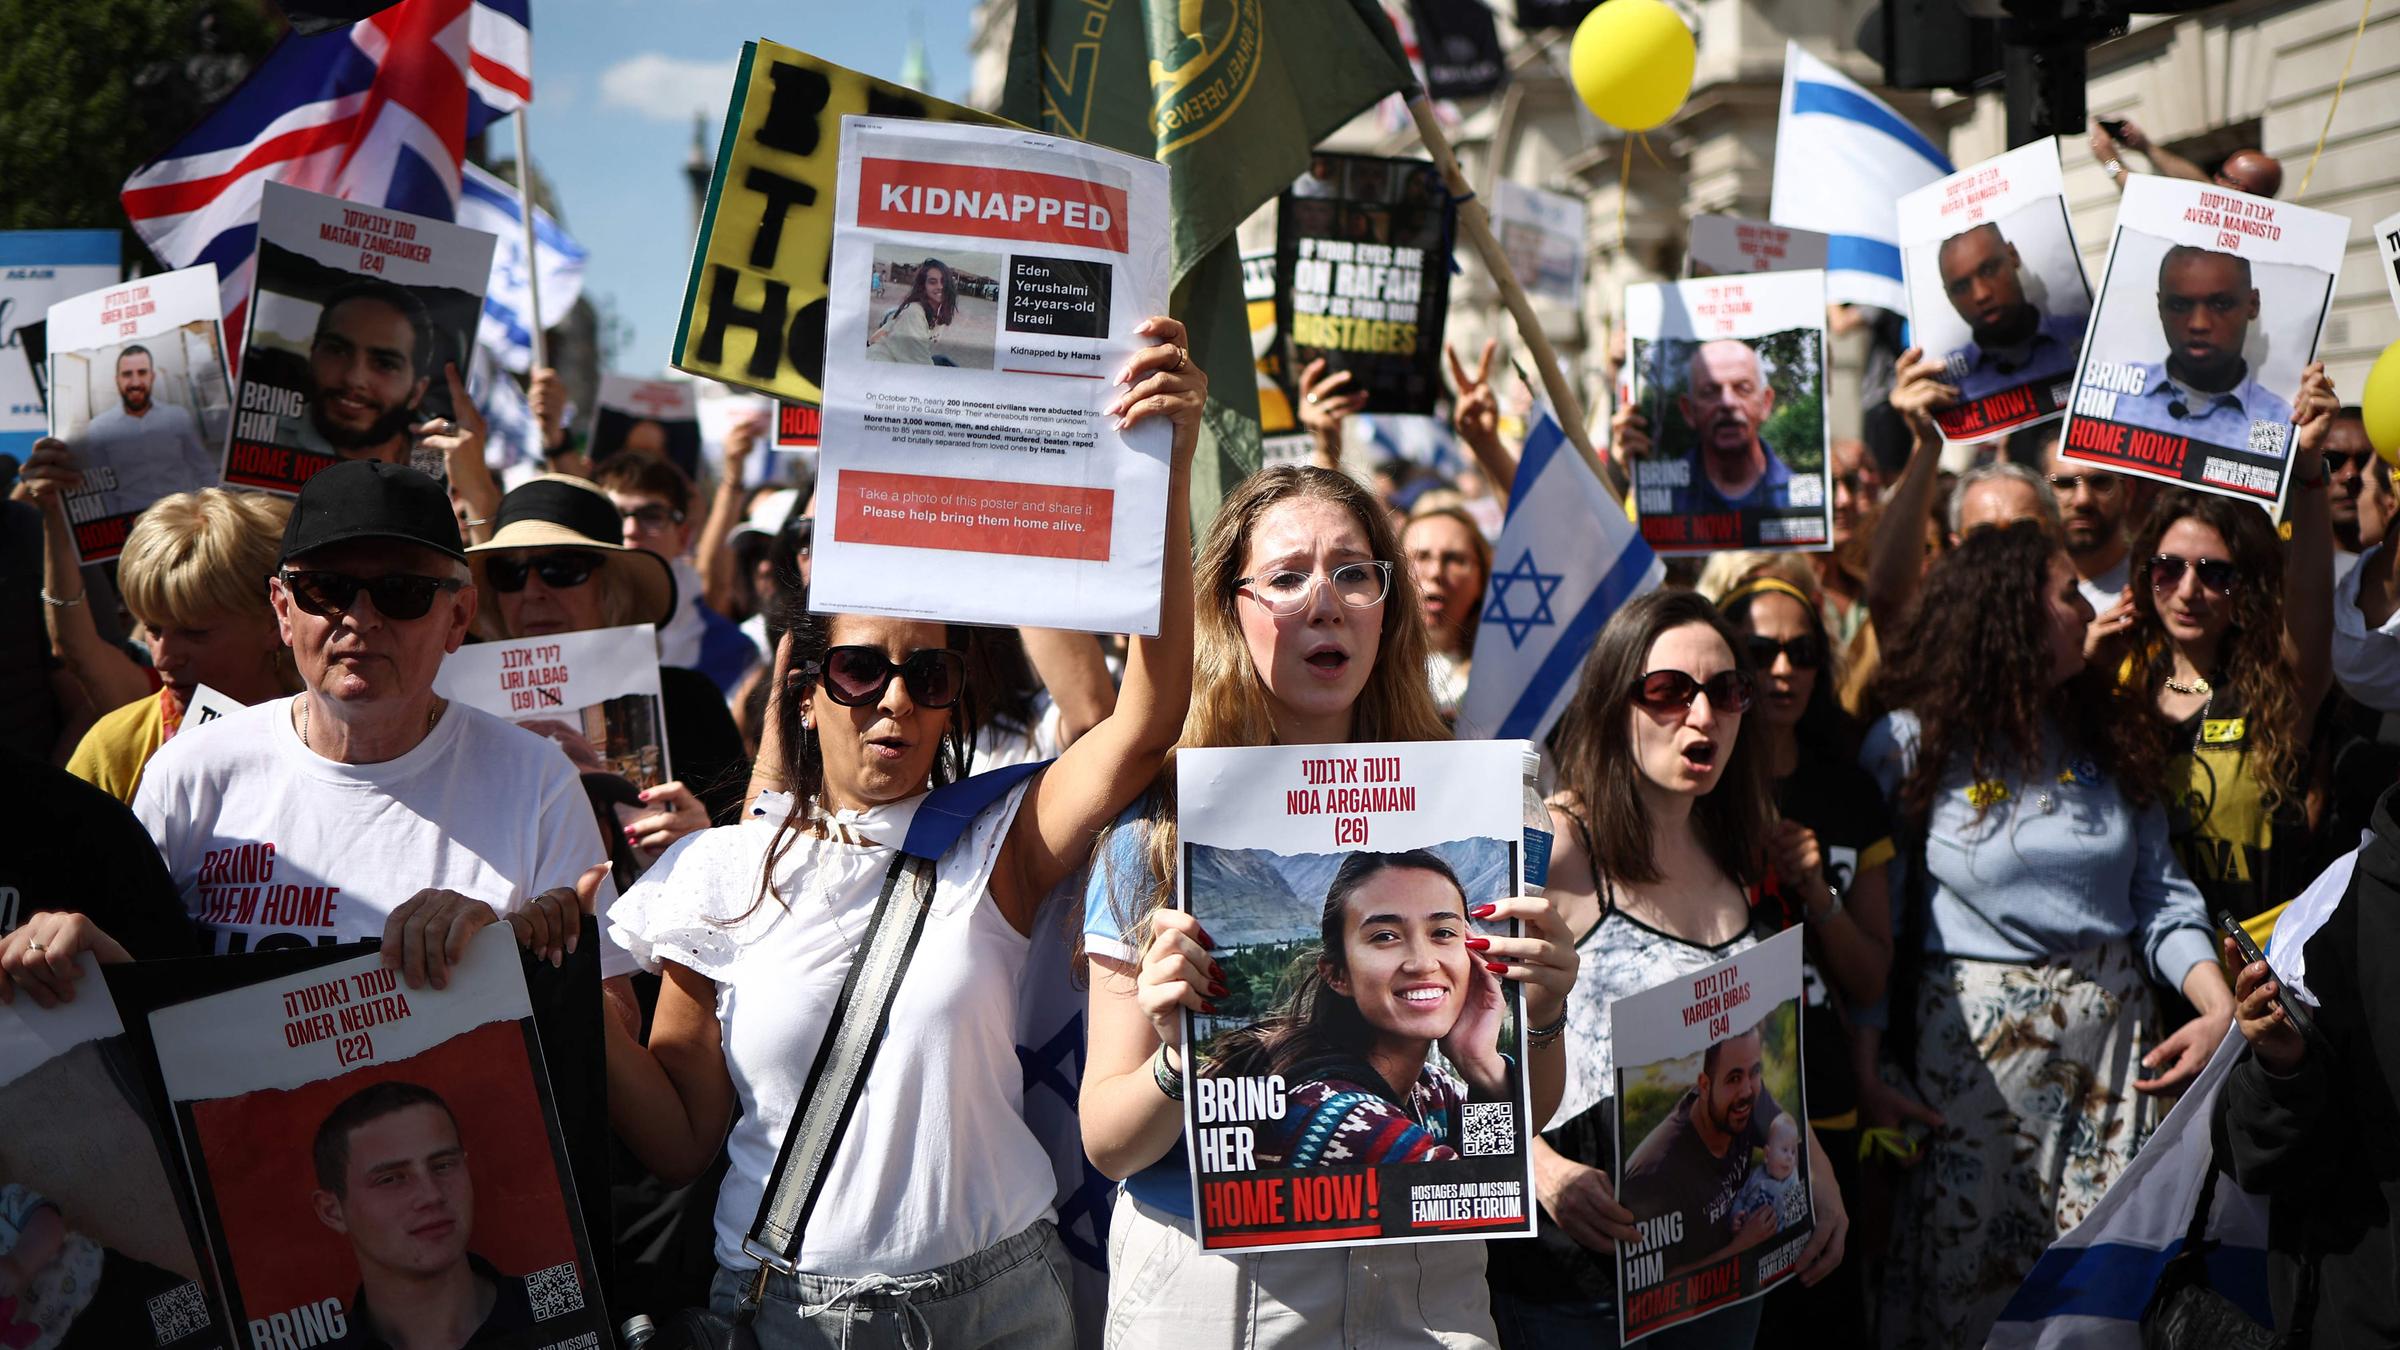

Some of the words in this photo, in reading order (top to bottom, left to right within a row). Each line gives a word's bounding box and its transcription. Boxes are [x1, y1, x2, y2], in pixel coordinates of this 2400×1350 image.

[880, 183, 1111, 232] KIDNAPPED
[2183, 207, 2221, 227] AVERA
[2223, 215, 2281, 242] MANGISTO
[319, 223, 361, 248] MATAN
[362, 233, 432, 264] ZANGAUKER
[2217, 230, 2240, 251] (36)
[360, 251, 386, 274] (24)
[1017, 264, 1050, 277] Eden
[1016, 280, 1088, 296] Yerushalmi
[1295, 260, 1332, 294] ON
[1335, 263, 1422, 303] RAFAH
[1013, 311, 1053, 325] Israeli
[1014, 296, 1095, 313] 24-years-old
[1294, 311, 1418, 354] HOSTAGES
[1010, 346, 1055, 358] Kidnapped
[1057, 350, 1069, 360] by
[1071, 351, 1101, 361] Hamas
[2084, 360, 2146, 396] BRING
[242, 380, 304, 418] BRING
[866, 392, 876, 400] On
[878, 393, 907, 402] October
[923, 398, 946, 407] nearly
[947, 399, 960, 407] 200
[962, 400, 994, 410] innocent
[996, 404, 1026, 412] civilians
[1028, 406, 1046, 414] were
[1048, 408, 1082, 416] abducted
[875, 402, 895, 410] Israel
[924, 406, 942, 414] Gaza
[965, 409, 982, 417] Their
[984, 411, 1028, 420] whereabouts
[1030, 415, 1054, 423] remain
[1983, 383, 2036, 424] NOW!
[2074, 386, 2118, 420] HIM
[236, 411, 279, 443] HIM
[864, 424, 890, 432] months
[912, 427, 931, 436] years
[884, 416, 900, 424] than
[974, 423, 989, 431] and
[1024, 427, 1052, 436] ranging
[1061, 430, 1074, 438] age
[1076, 431, 1092, 439] from
[907, 436, 934, 446] brutally
[935, 439, 970, 449] separated
[972, 440, 988, 448] from
[990, 442, 1008, 450] loved
[1010, 444, 1028, 452] ones
[1029, 446, 1038, 454] by
[2069, 418, 2127, 454] HOME
[2128, 429, 2189, 469] NOW!
[231, 442, 289, 479] HOME
[1638, 459, 1690, 487] BRING
[2203, 464, 2244, 486] FAMILIES
[2244, 473, 2278, 494] FORUM
[67, 494, 107, 524] HIM
[859, 487, 888, 501] Take
[891, 492, 899, 501] a
[903, 492, 937, 504] photo
[941, 493, 953, 504] of
[956, 495, 977, 507] this
[980, 498, 1018, 511] poster
[1022, 500, 1045, 512] and
[1048, 502, 1082, 515] share
[1085, 505, 1092, 516] it
[1640, 488, 1672, 514] HIM
[863, 505, 905, 519] Please
[909, 508, 937, 522] help
[940, 510, 974, 526] bring
[978, 514, 1010, 527] them
[1014, 516, 1049, 530] home
[1052, 519, 1086, 532] alive.
[1642, 514, 1688, 541] HOME
[1693, 511, 1742, 541] NOW!
[78, 519, 125, 549] HOME
[536, 644, 560, 664] לירי
[500, 670, 524, 690] LIRI
[528, 665, 568, 687] ALBAG
[511, 689, 535, 712] (19)
[1302, 758, 1358, 785] ארגמני
[1363, 757, 1401, 783] נועה
[1287, 789, 1321, 815] NOA
[1326, 786, 1416, 814] ARGAMANI
[1335, 816, 1369, 846] (26)
[198, 842, 275, 885] BRING
[196, 887, 261, 924] THEM
[261, 884, 340, 927] HOME
[352, 967, 397, 999] עומר
[1694, 975, 1718, 1000] ביבס
[1719, 965, 1738, 992] ירדן
[283, 979, 350, 1018] נאוטרה
[1682, 995, 1721, 1027] YARDEN
[1723, 982, 1751, 1011] BIBAS
[284, 1013, 338, 1048] OMER
[338, 993, 412, 1034] NEUTRA
[1710, 1012, 1730, 1041] (34)
[336, 1031, 374, 1067] (22)
[1197, 1074, 1287, 1123] BRING
[1200, 1126, 1257, 1173] HER
[1204, 1178, 1285, 1228] HOME
[1293, 1168, 1381, 1223] NOW!
[1411, 1184, 1458, 1200] HOSTAGES
[1459, 1183, 1478, 1198] AND
[1479, 1181, 1520, 1197] MISSING
[1412, 1198, 1471, 1222] FAMILIES
[1473, 1196, 1521, 1219] FORUM
[1626, 1251, 1664, 1292] HIM
[1759, 1253, 1789, 1281] FAMILIES
[1627, 1280, 1681, 1327] HOME
[1687, 1255, 1741, 1306] NOW!
[248, 1297, 348, 1350] BRING
[556, 1330, 599, 1350] MISSING
